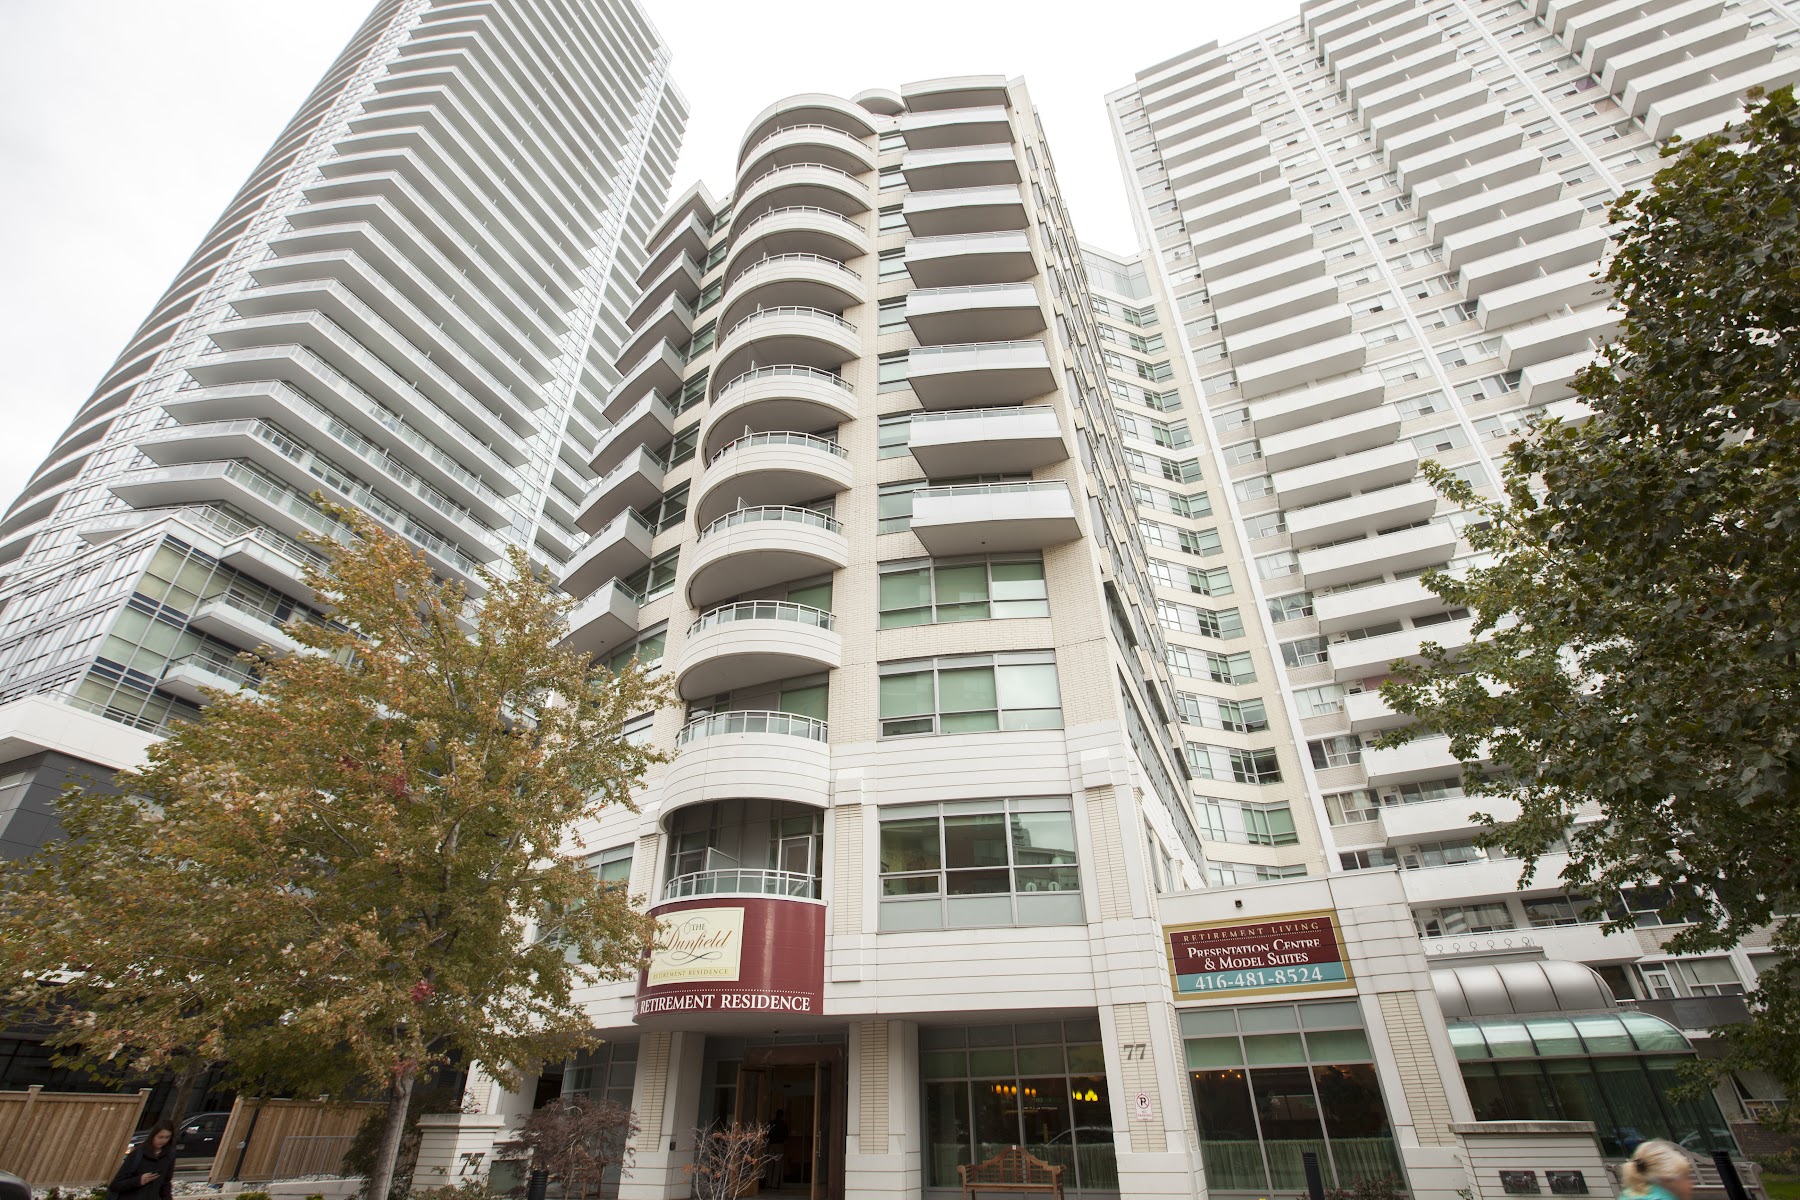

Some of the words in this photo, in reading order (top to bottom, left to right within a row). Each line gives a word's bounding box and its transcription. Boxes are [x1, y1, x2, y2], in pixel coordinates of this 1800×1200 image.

[656, 923, 733, 960] Dunfield
[1183, 927, 1264, 942] RETIREMENT
[1271, 922, 1320, 934] LIVING
[1204, 958, 1216, 971] &
[1219, 954, 1265, 970] MODEL
[1267, 952, 1309, 965] SUITES
[1195, 966, 1324, 990] 416-481-8524
[640, 994, 715, 1014] RETIREMENT
[721, 994, 811, 1012] RESIDENCE
[1124, 1043, 1146, 1060] 77
[459, 1152, 486, 1175] 77
